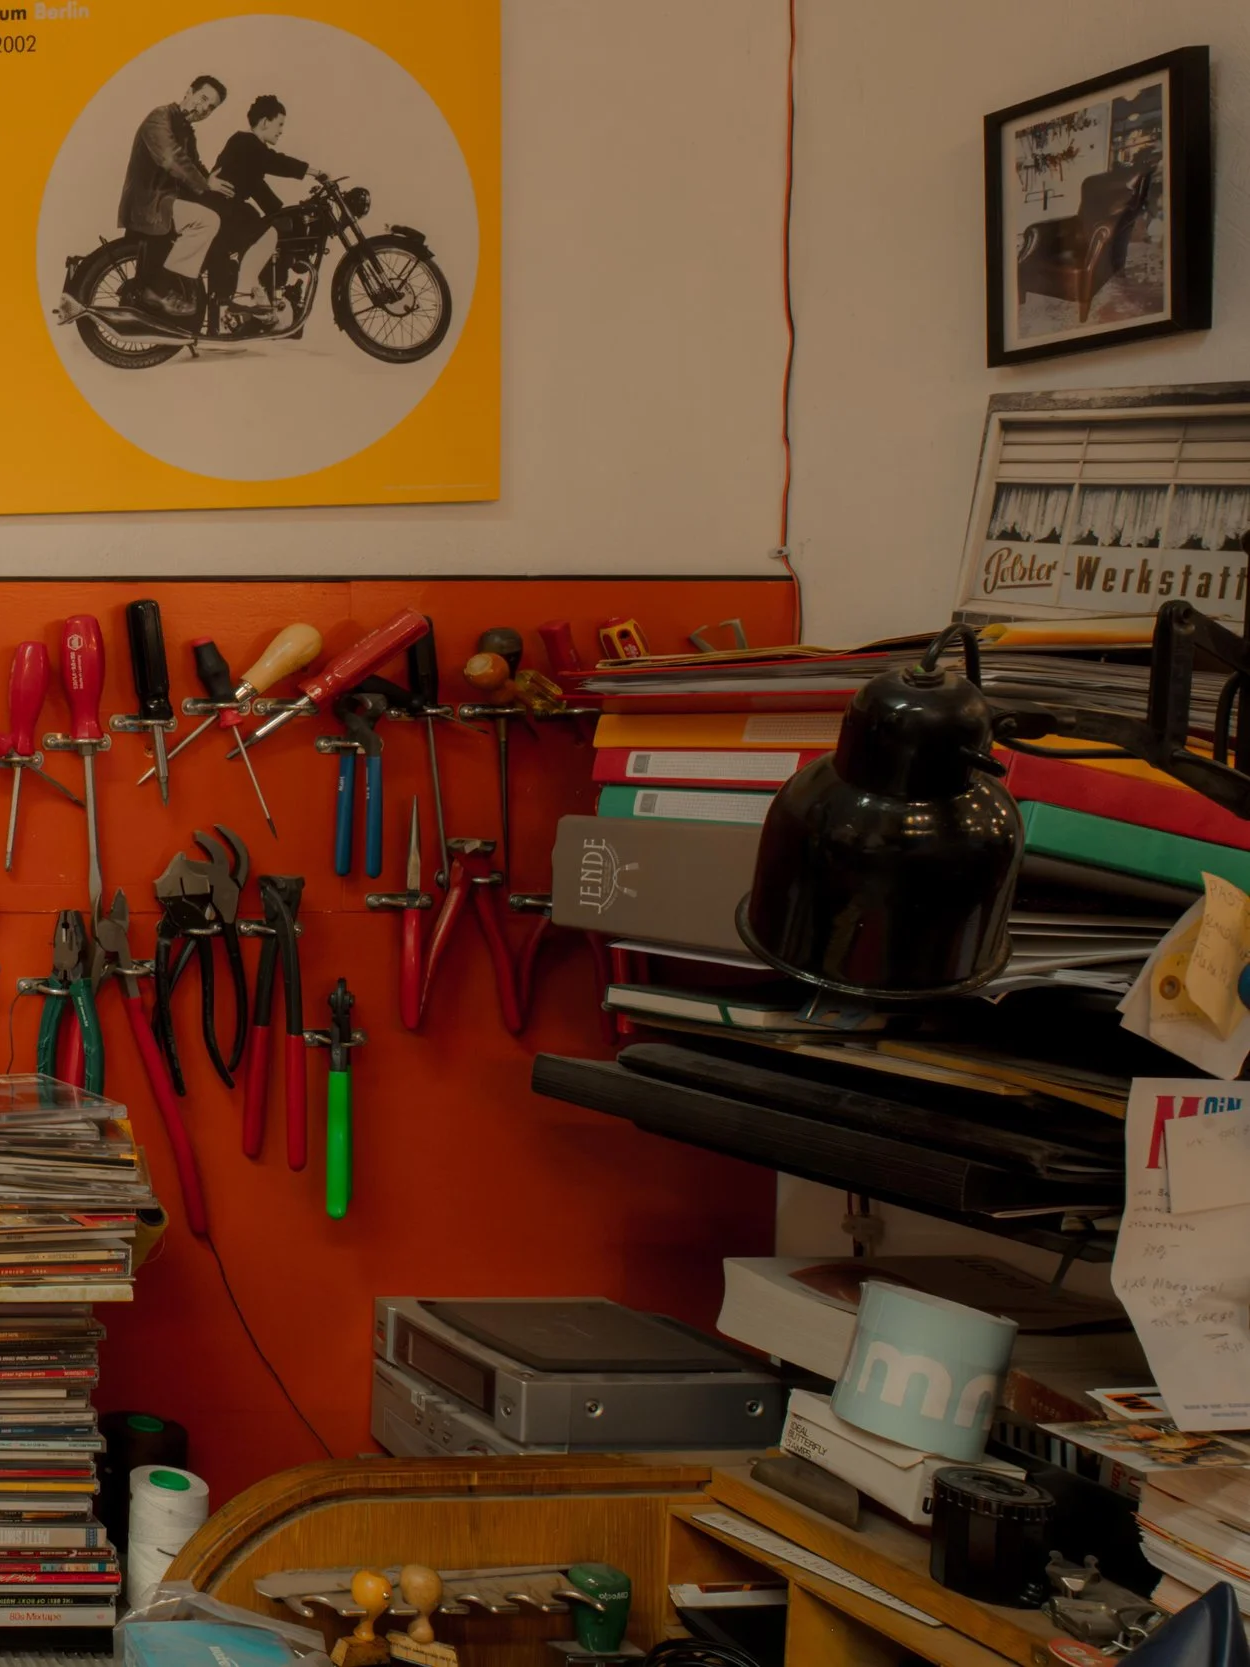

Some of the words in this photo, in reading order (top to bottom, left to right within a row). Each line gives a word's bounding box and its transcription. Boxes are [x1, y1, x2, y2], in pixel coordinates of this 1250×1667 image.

[33, 2, 90, 20] Berlin
[983, 547, 1059, 594] Polster
[579, 838, 606, 914] JENDE
[790, 1422, 809, 1437] IDEAL
[788, 1430, 828, 1456] BUTTERFLY
[9, 1613, 25, 1621] 80s
[26, 1613, 62, 1622] Mixtape
